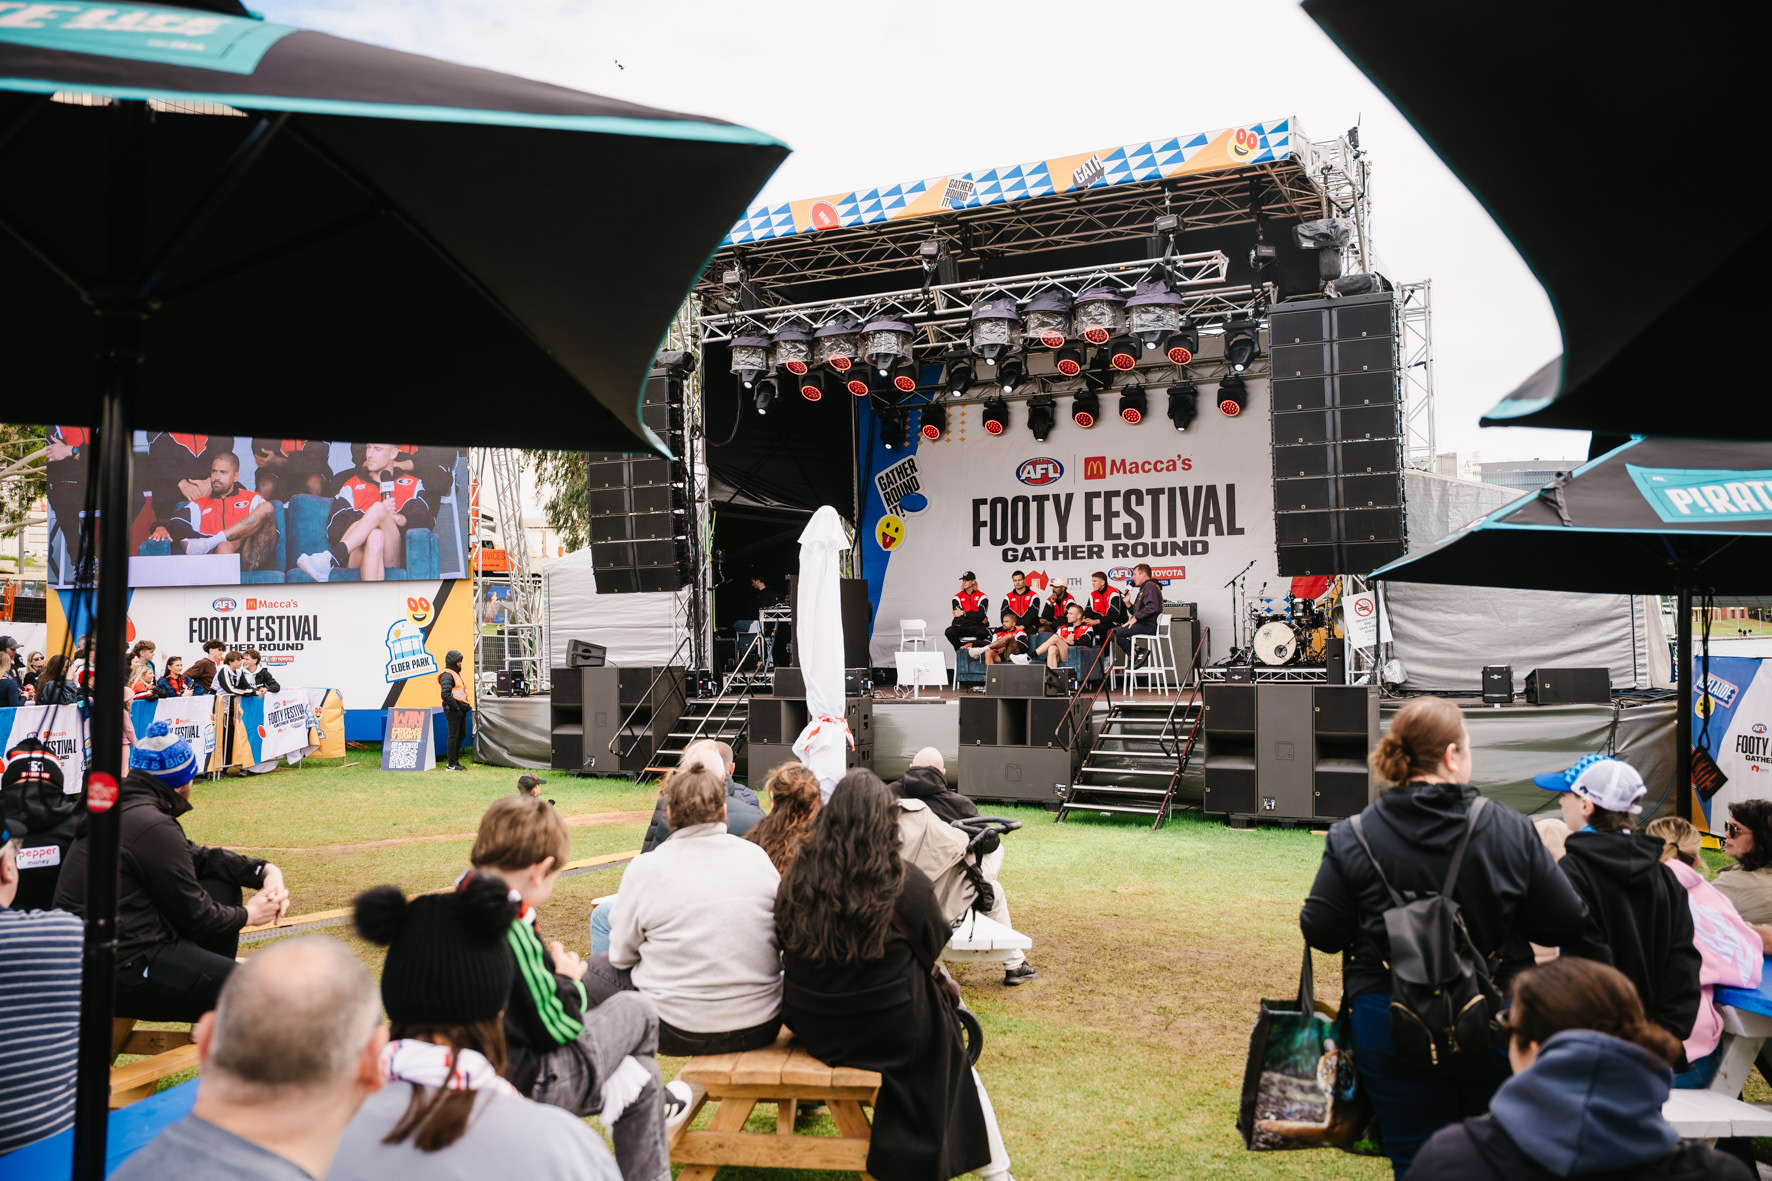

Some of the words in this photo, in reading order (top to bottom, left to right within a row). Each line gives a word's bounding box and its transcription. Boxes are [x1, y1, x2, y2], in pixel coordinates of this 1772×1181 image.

[1073, 153, 1104, 184] GATH
[949, 178, 974, 193] GATHER
[945, 189, 969, 202] ROUND
[1020, 463, 1061, 479] AFL
[1109, 454, 1193, 476] Macca's
[877, 457, 918, 492] GATHER
[883, 475, 921, 508] ROUND
[972, 492, 1075, 547] FOOTY
[1083, 483, 1246, 542] FESTIVAL
[1001, 543, 1105, 563] GATHER
[1111, 539, 1210, 559] ROUND
[1110, 569, 1132, 578] AFL
[1151, 569, 1184, 578] TOYOTA
[1050, 577, 1082, 586] STH
[214, 599, 235, 609] AFL
[258, 599, 299, 609] Macca's
[188, 616, 242, 643] FOOTY
[246, 615, 322, 642] FESTIVAL
[226, 643, 256, 652] THER
[258, 642, 304, 652] ROUND
[390, 661, 411, 674] ELDER
[411, 656, 431, 669] PARK
[284, 704, 305, 719] FESTIVA
[393, 710, 425, 725] WIN
[1735, 735, 1769, 756] FOOTY
[1745, 755, 1772, 764] GATHE
[18, 847, 57, 861] pepper
